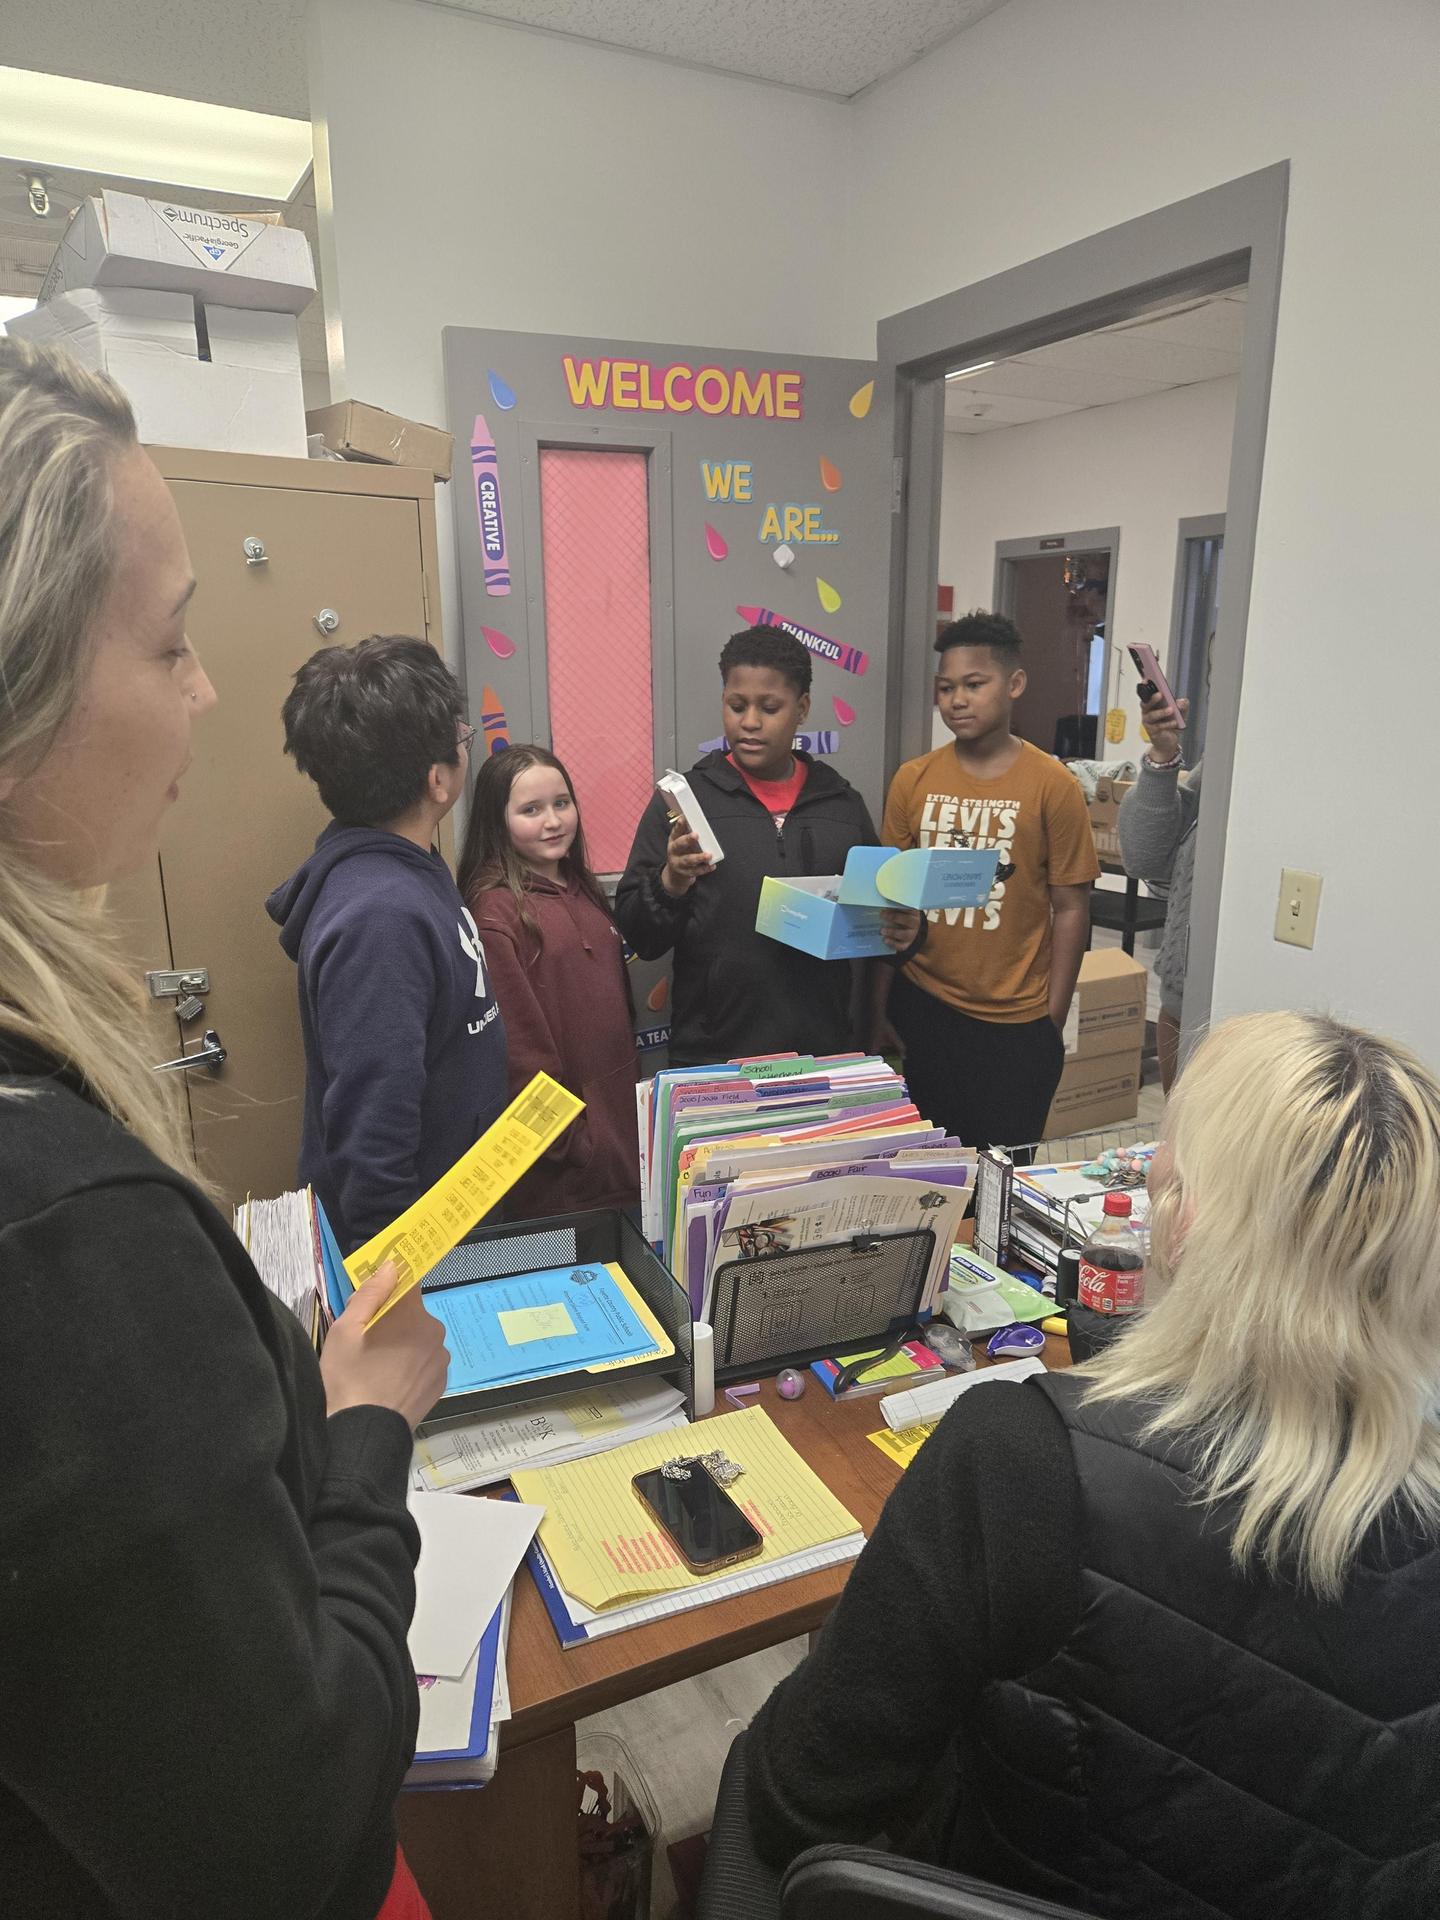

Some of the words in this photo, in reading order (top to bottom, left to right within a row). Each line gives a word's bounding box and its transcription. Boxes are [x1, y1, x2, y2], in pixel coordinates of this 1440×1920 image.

[178, 210, 249, 238] Spectrum
[562, 357, 801, 419] WELCOME
[702, 462, 753, 501] WE
[480, 481, 501, 551] CREATIVE
[760, 506, 839, 543] ARE...
[920, 801, 1019, 839] LEVI'S
[926, 793, 960, 805] EXTRA
[961, 798, 1021, 810] STRENGTH
[743, 1064, 773, 1074] School
[693, 1188, 712, 1199] Fun
